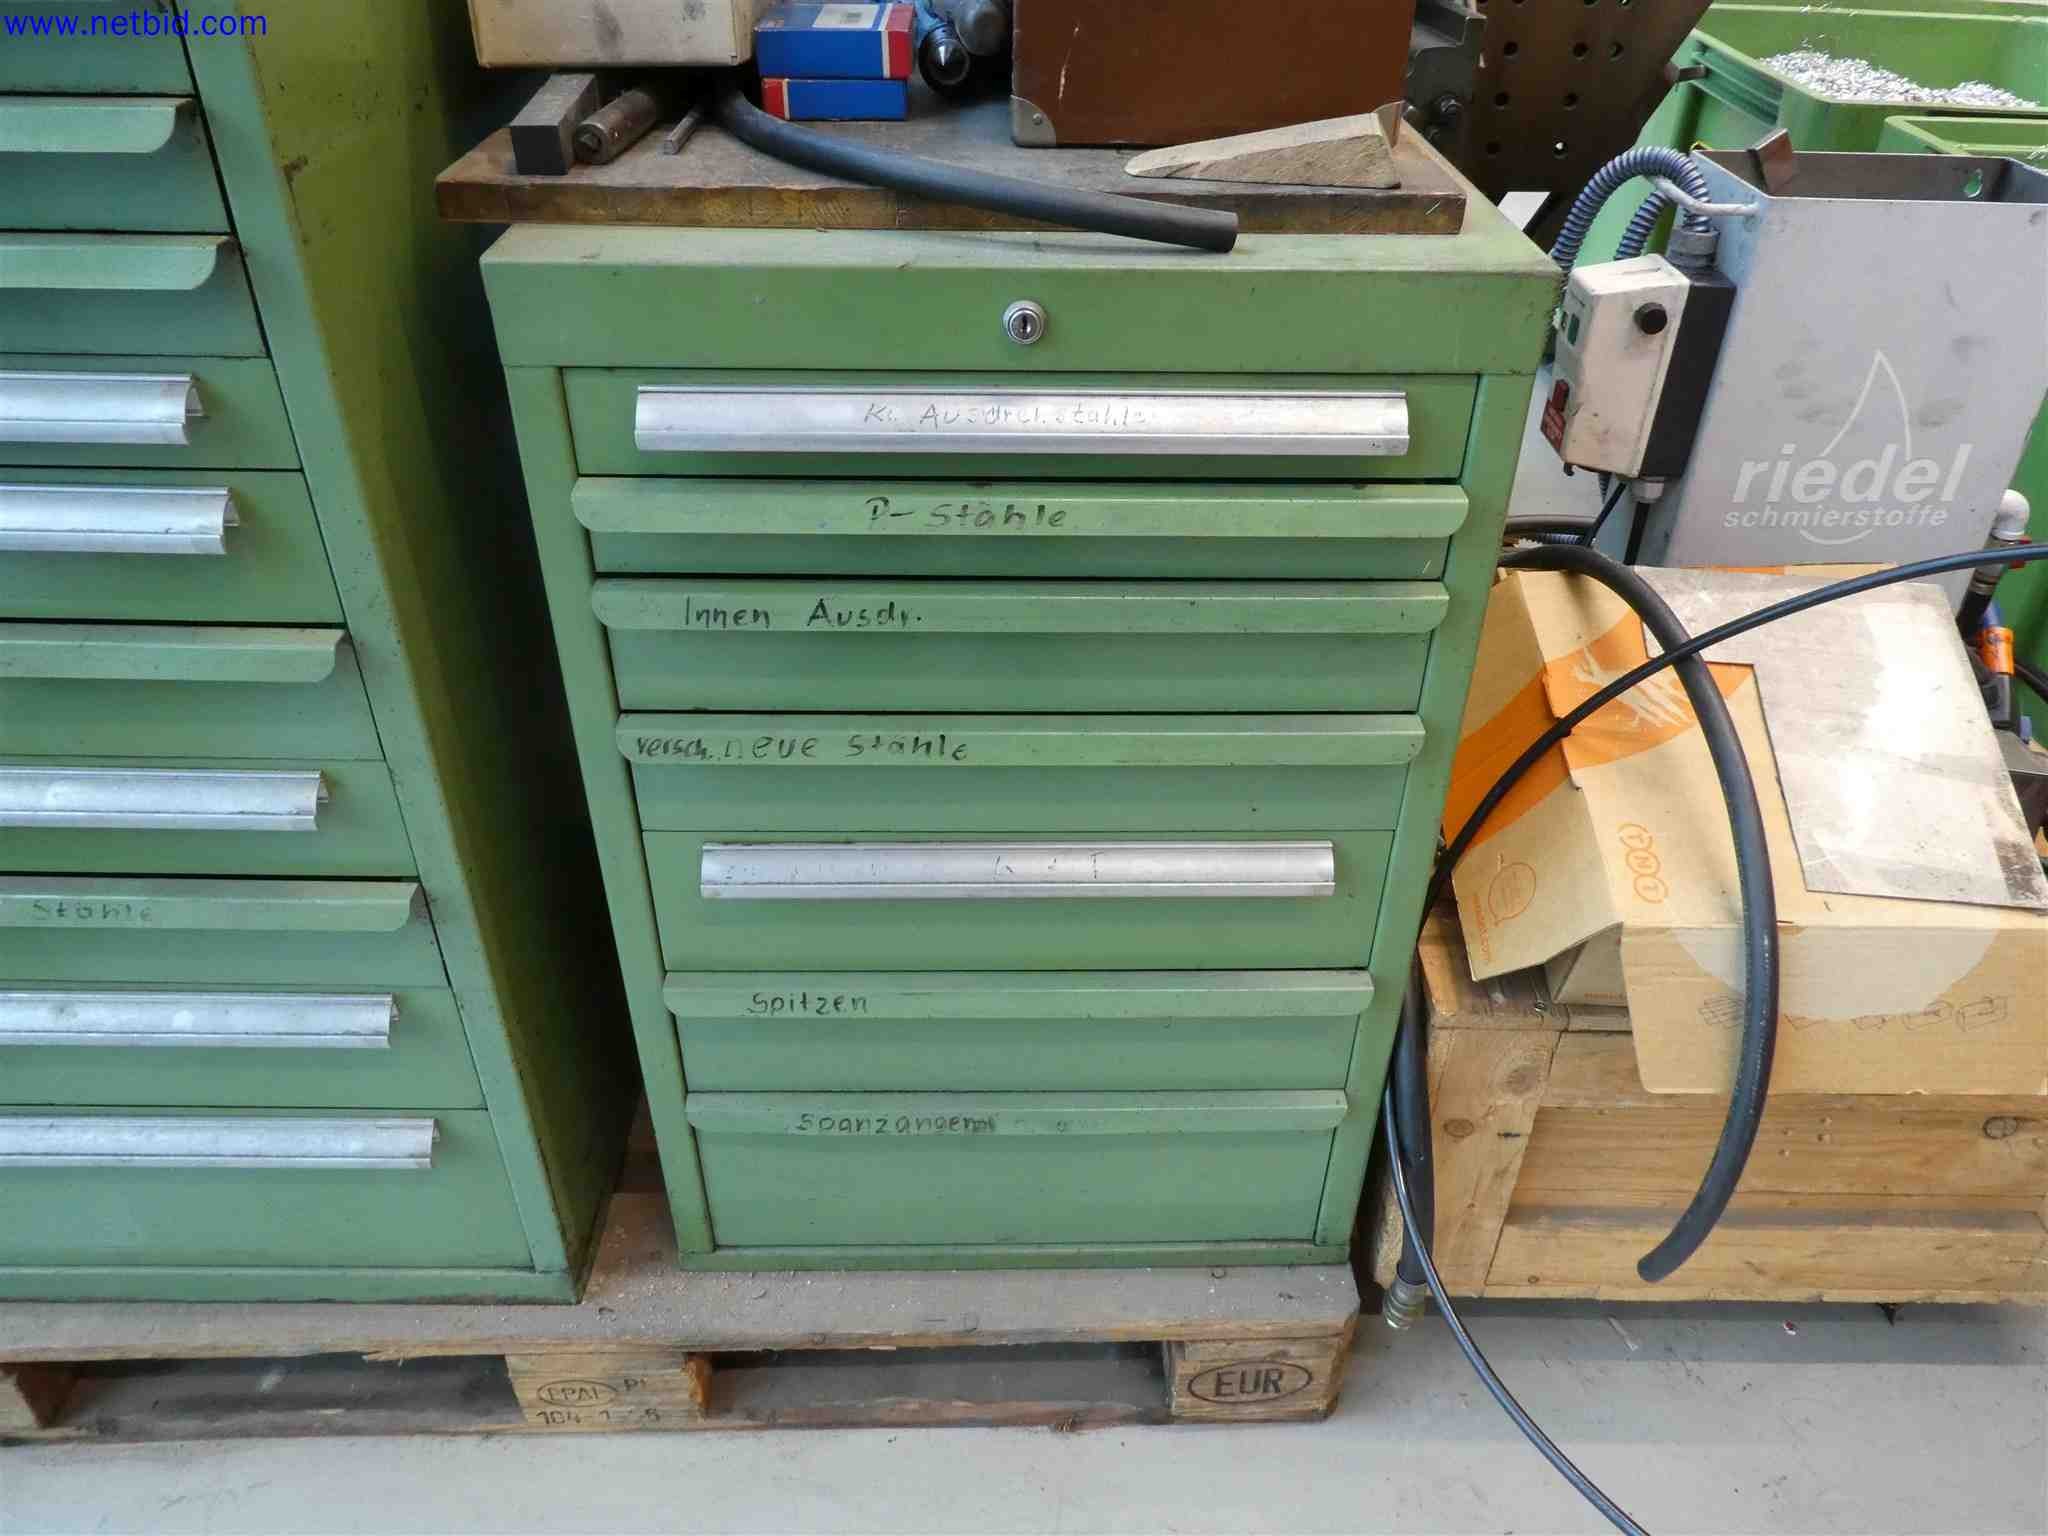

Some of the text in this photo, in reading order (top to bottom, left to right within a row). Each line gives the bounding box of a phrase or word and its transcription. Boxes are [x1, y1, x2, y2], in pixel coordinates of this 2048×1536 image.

[1732, 443, 1973, 502] riedel
[1723, 504, 1948, 528] schmierstoffe
[684, 596, 770, 628] Innen
[747, 991, 869, 1016] Spitzen
[1215, 1368, 1284, 1396] EUR
